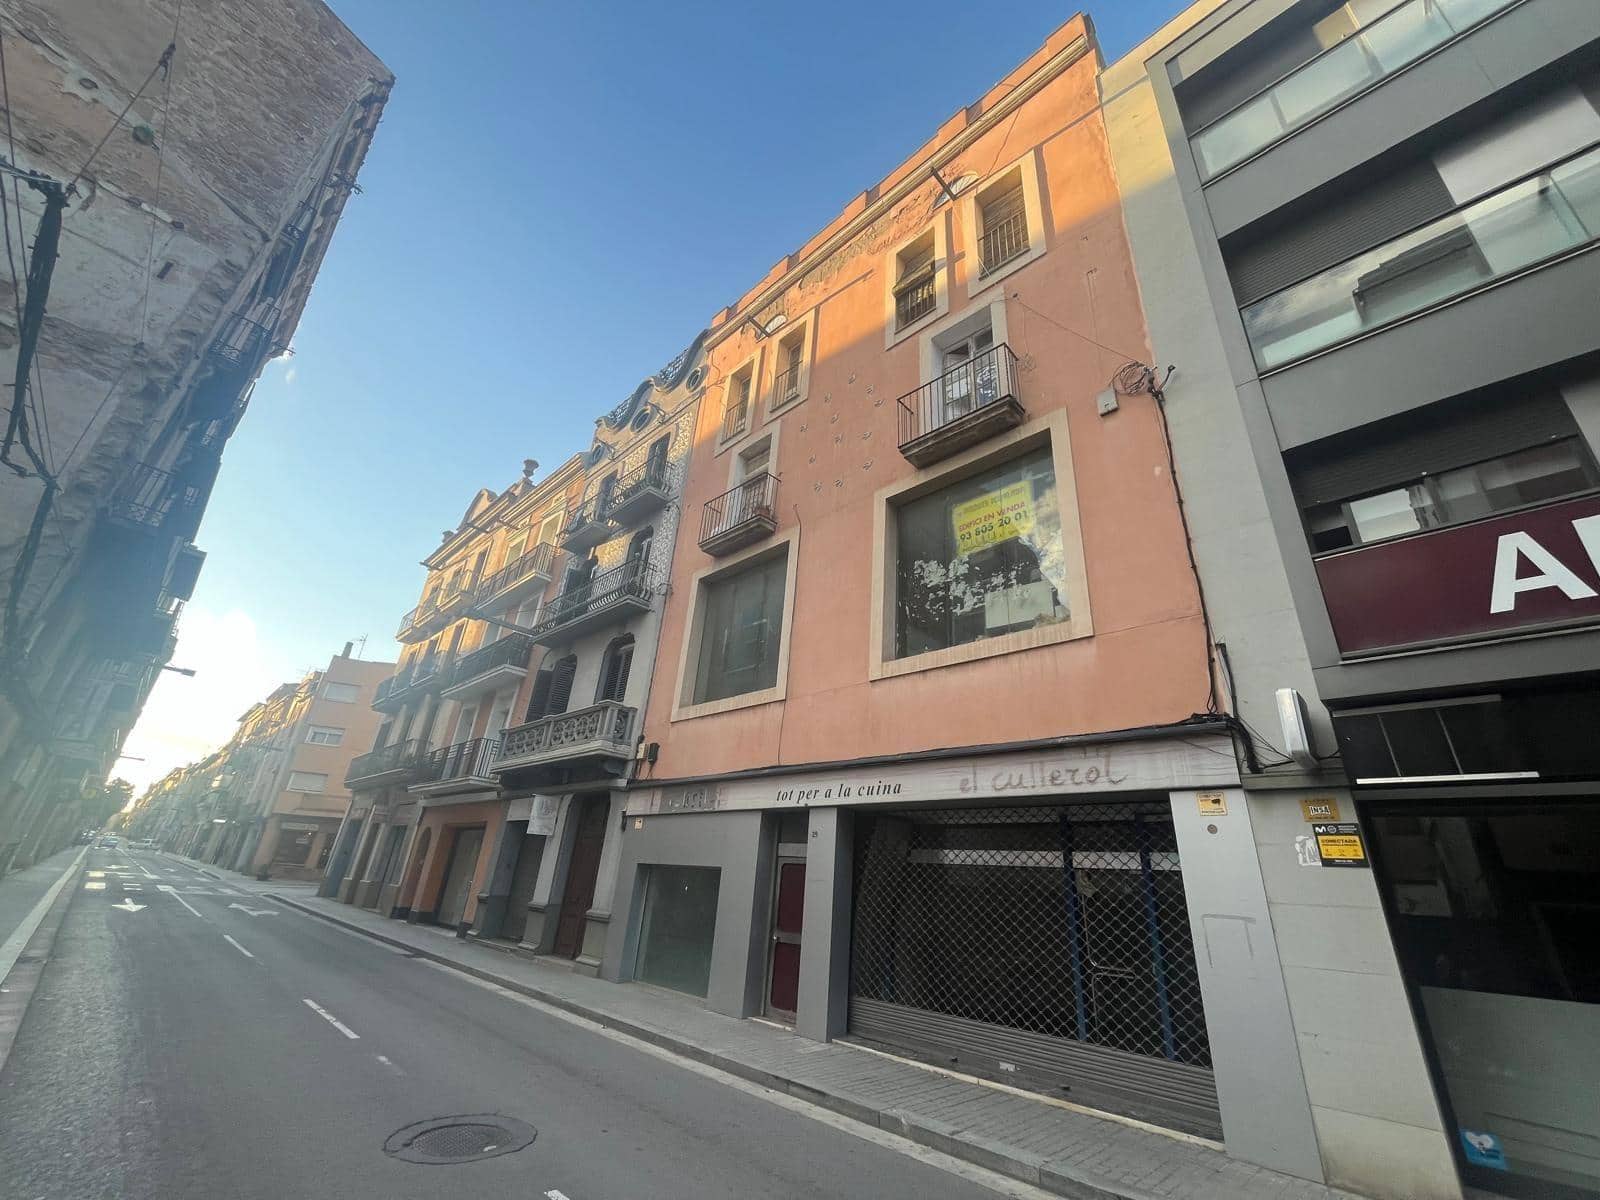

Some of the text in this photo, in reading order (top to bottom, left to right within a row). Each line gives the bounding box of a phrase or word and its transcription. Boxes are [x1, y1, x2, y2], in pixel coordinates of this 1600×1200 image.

[983, 511, 995, 522] EN
[995, 501, 1026, 518] VENDA
[959, 531, 972, 541] 93
[997, 516, 1011, 528] 20
[1014, 510, 1028, 521] 01
[776, 780, 902, 804] tot per a la cuina
